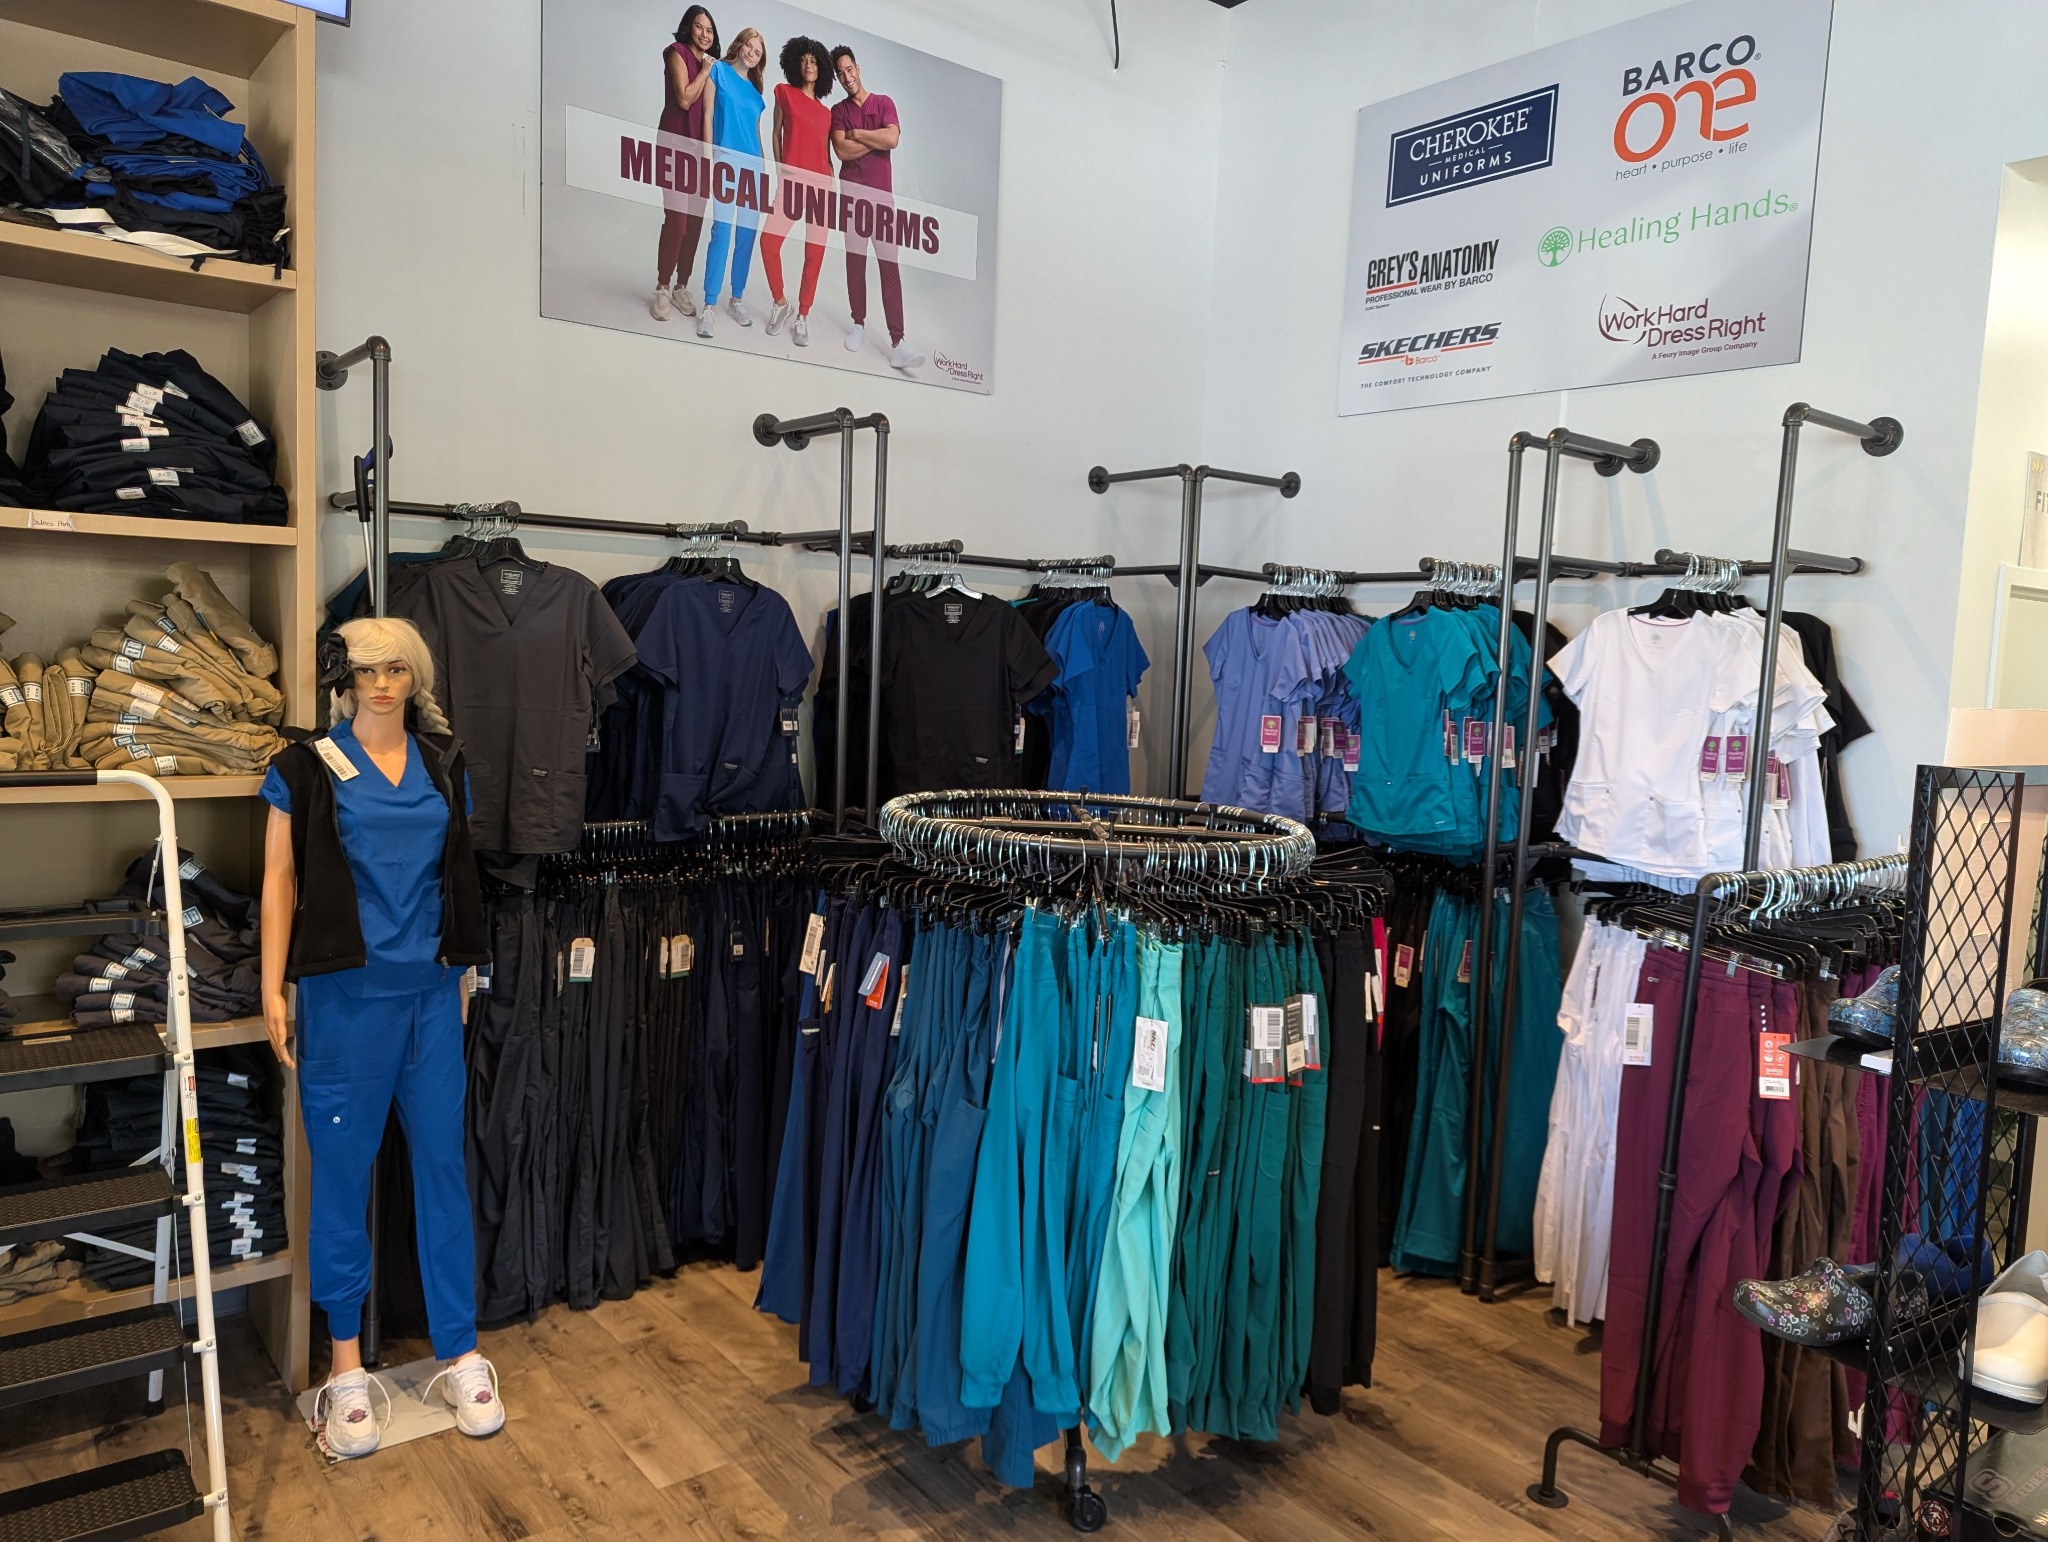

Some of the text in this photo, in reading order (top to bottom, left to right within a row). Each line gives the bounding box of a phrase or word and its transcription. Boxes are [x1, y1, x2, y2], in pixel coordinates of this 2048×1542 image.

[1622, 34, 1756, 96] BARCO
[1409, 107, 1529, 162] CHEROKEE
[1419, 151, 1512, 186] UNIFORMS
[1444, 146, 1486, 164] MEDICAL
[1615, 141, 1748, 181] heart purpose life
[620, 135, 940, 255] MEDICAL UNIFORMS
[1577, 211, 1682, 253] Healing
[1367, 239, 1500, 290] GREY'S ANATOMY
[1365, 272, 1494, 305] PROFESSIONAL WEAR BY BARCO
[1358, 321, 1502, 361] SKECHERS
[1651, 352, 1658, 360] A
[1678, 347, 1700, 357] Image
[1701, 344, 1723, 354] Group
[1723, 340, 1758, 351] Company
[1374, 377, 1406, 388] COMFORT
[1407, 370, 1454, 383] TECHNOLOGY
[1455, 365, 1491, 376] COMPANY
